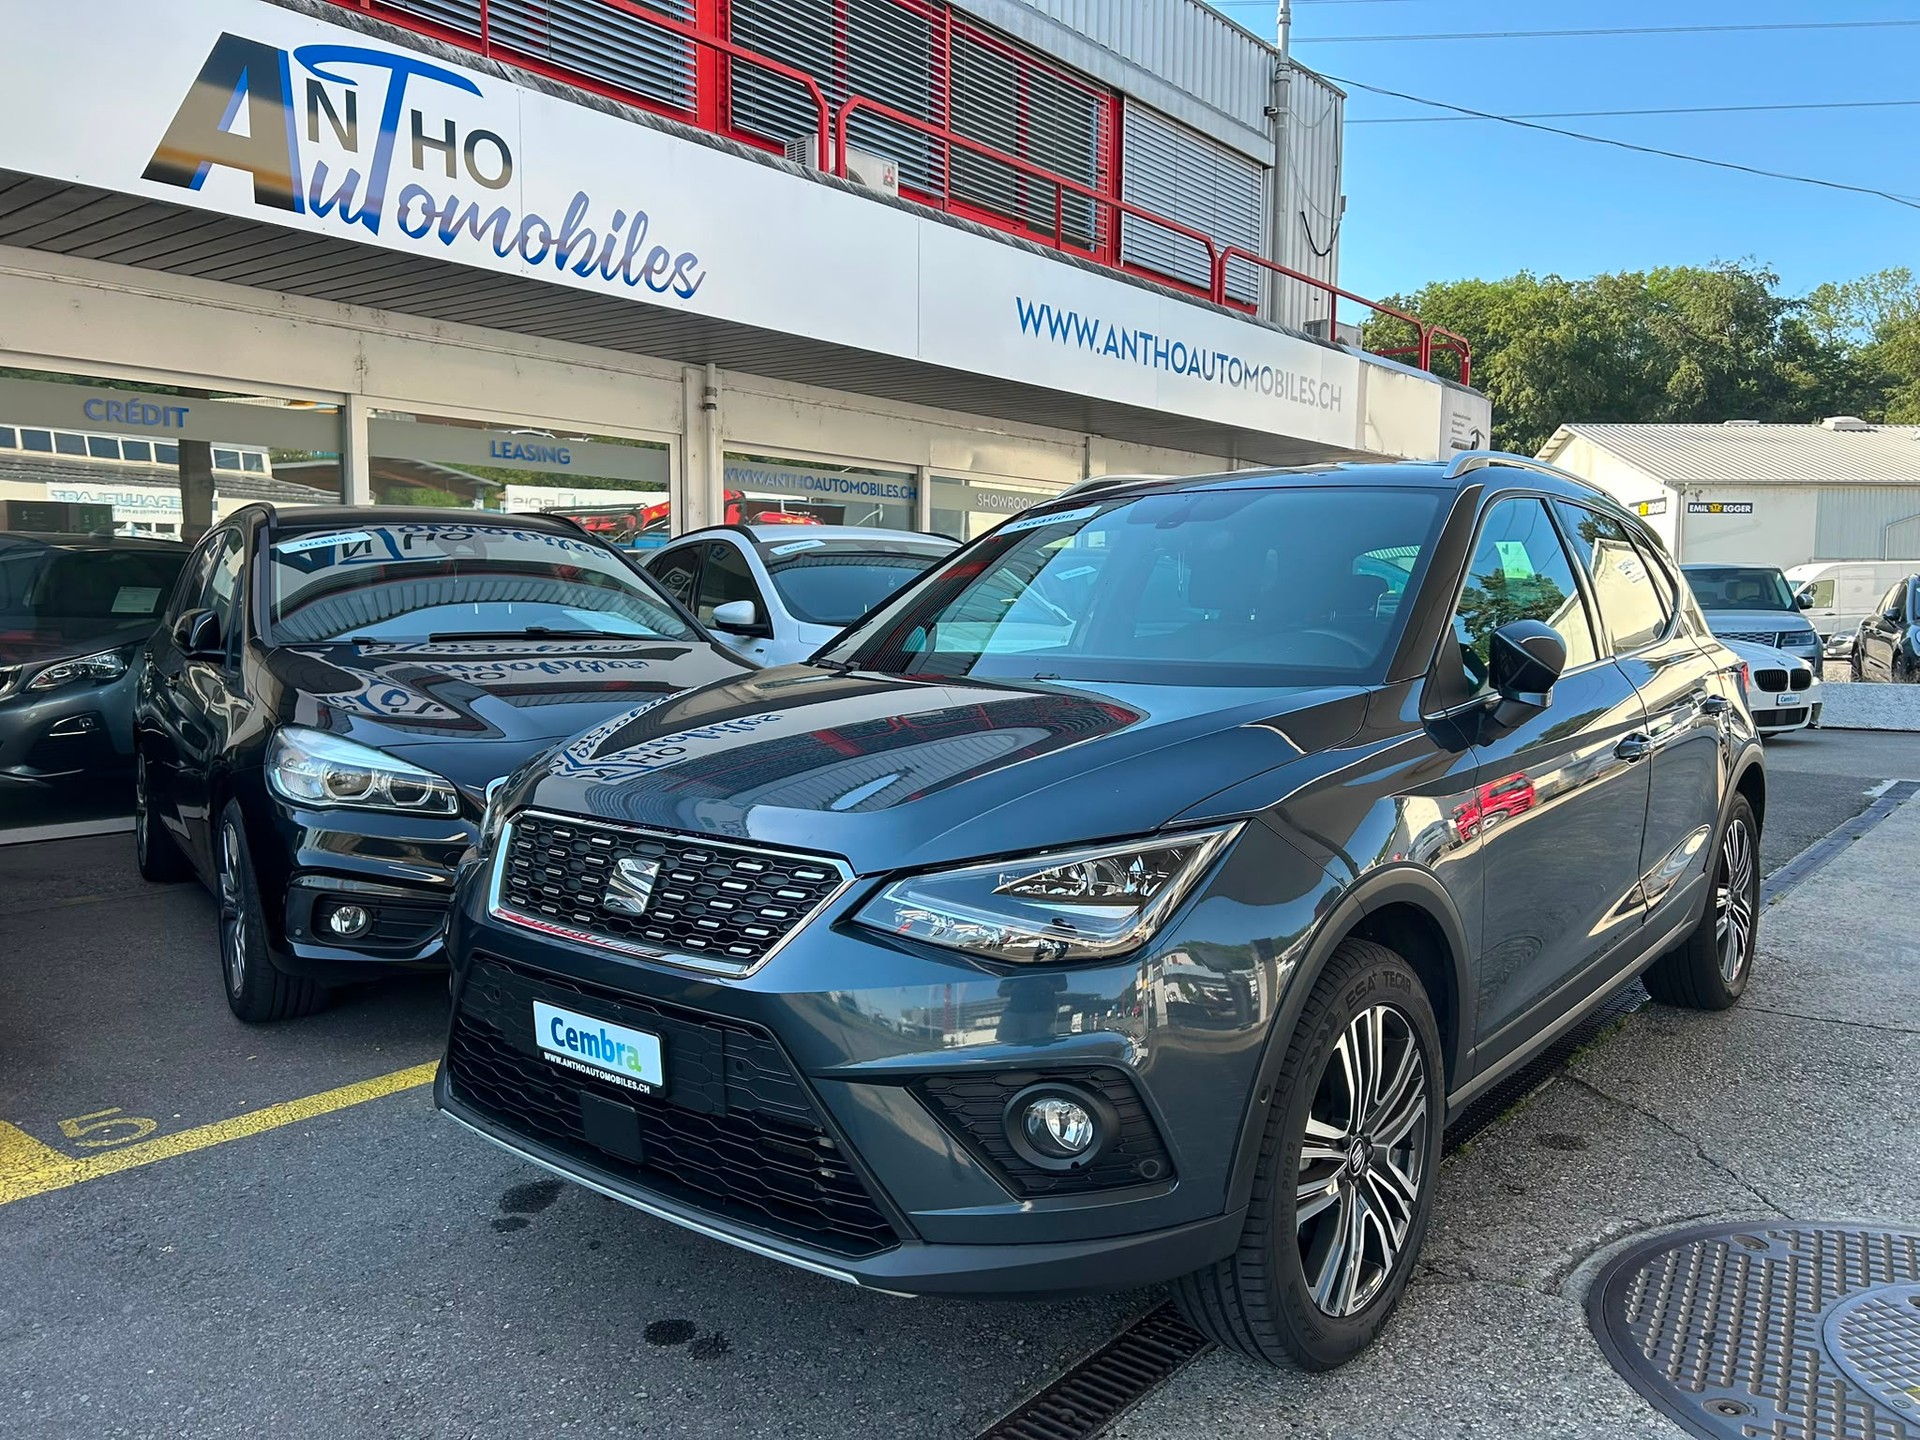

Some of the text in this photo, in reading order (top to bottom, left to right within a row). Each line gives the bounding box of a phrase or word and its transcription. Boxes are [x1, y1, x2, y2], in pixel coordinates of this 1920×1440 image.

[1015, 296, 1342, 413] WWW.ANTHOAUTOMOBILES.CH
[84, 398, 190, 428] CRÉDIT
[490, 440, 571, 465] LEASING
[1016, 514, 1075, 529] Occasion
[1689, 504, 1751, 513] EMIL EGGER
[299, 536, 352, 548] Occasion
[550, 1016, 642, 1072] Cembra
[543, 1051, 650, 1095] WWW.ANTHOAUTOMOBILES.CH
[57, 1107, 158, 1147] 5
